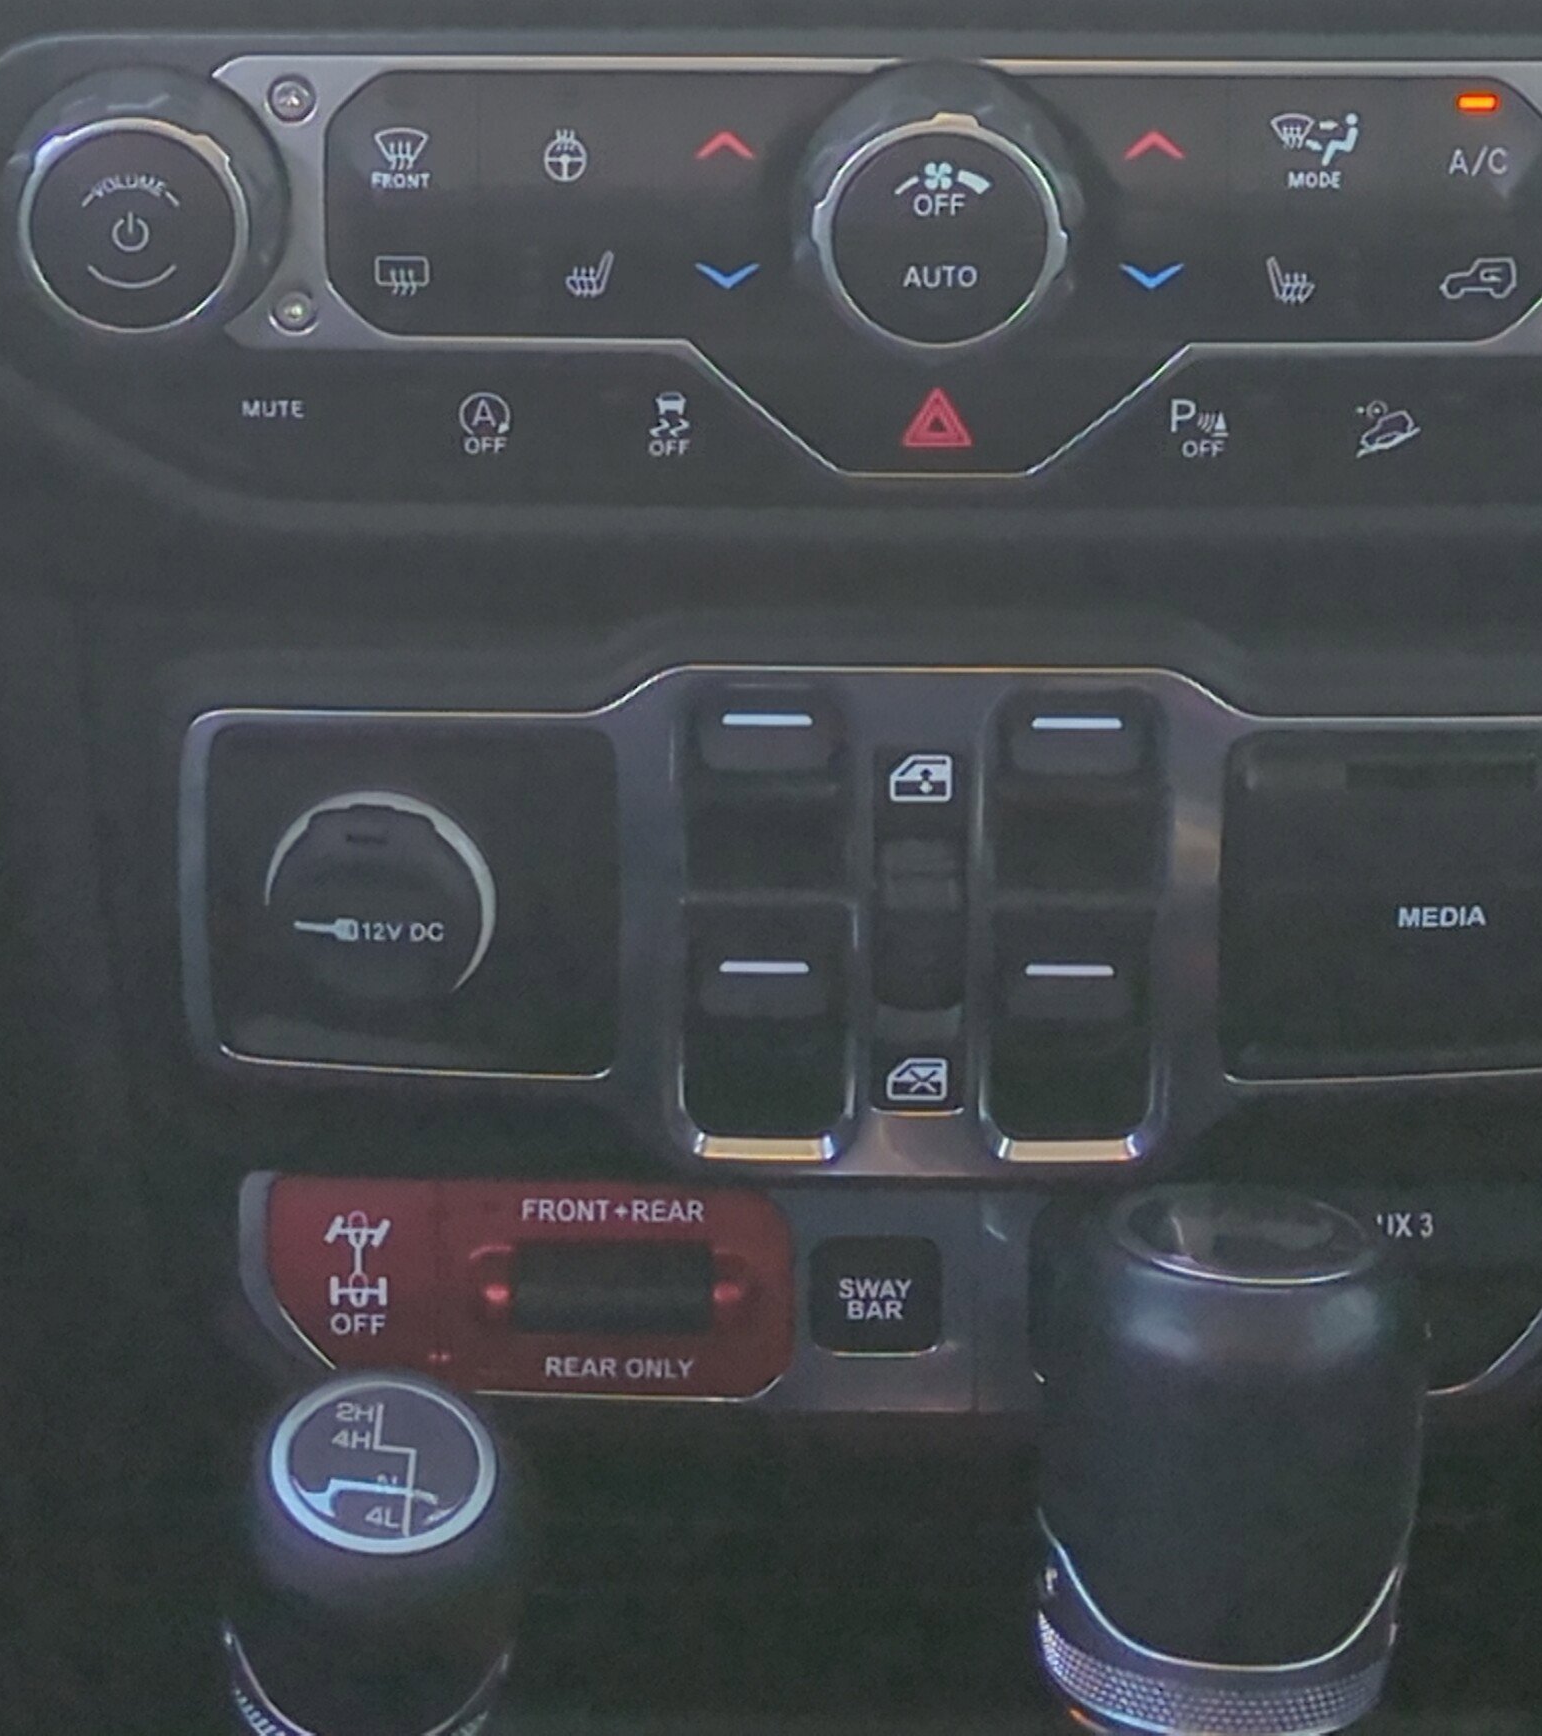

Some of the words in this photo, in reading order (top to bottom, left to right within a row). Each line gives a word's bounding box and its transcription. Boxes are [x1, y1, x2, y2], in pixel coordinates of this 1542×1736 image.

[1448, 148, 1508, 175] A/C
[92, 173, 166, 198] VOLUME
[372, 171, 431, 189] FRONT
[1288, 170, 1342, 189] MODE
[914, 193, 965, 216] OFF
[903, 265, 978, 288] AUTO
[241, 399, 305, 419] MUTE
[463, 436, 507, 456] OFF
[649, 438, 690, 457] OFF
[1182, 440, 1224, 457] OFF
[1397, 905, 1486, 928] MEDIA
[361, 922, 402, 941] 12V
[410, 922, 444, 942] DC
[1419, 1211, 1434, 1239] 3
[838, 1277, 912, 1301] SWAY
[846, 1299, 904, 1321] BAR
[331, 1314, 386, 1335] OFF
[545, 1356, 616, 1379] REAR
[626, 1358, 694, 1381] ONLY
[336, 1402, 374, 1423] 2H
[332, 1428, 371, 1450] 4H
[365, 1505, 399, 1529] 4L
